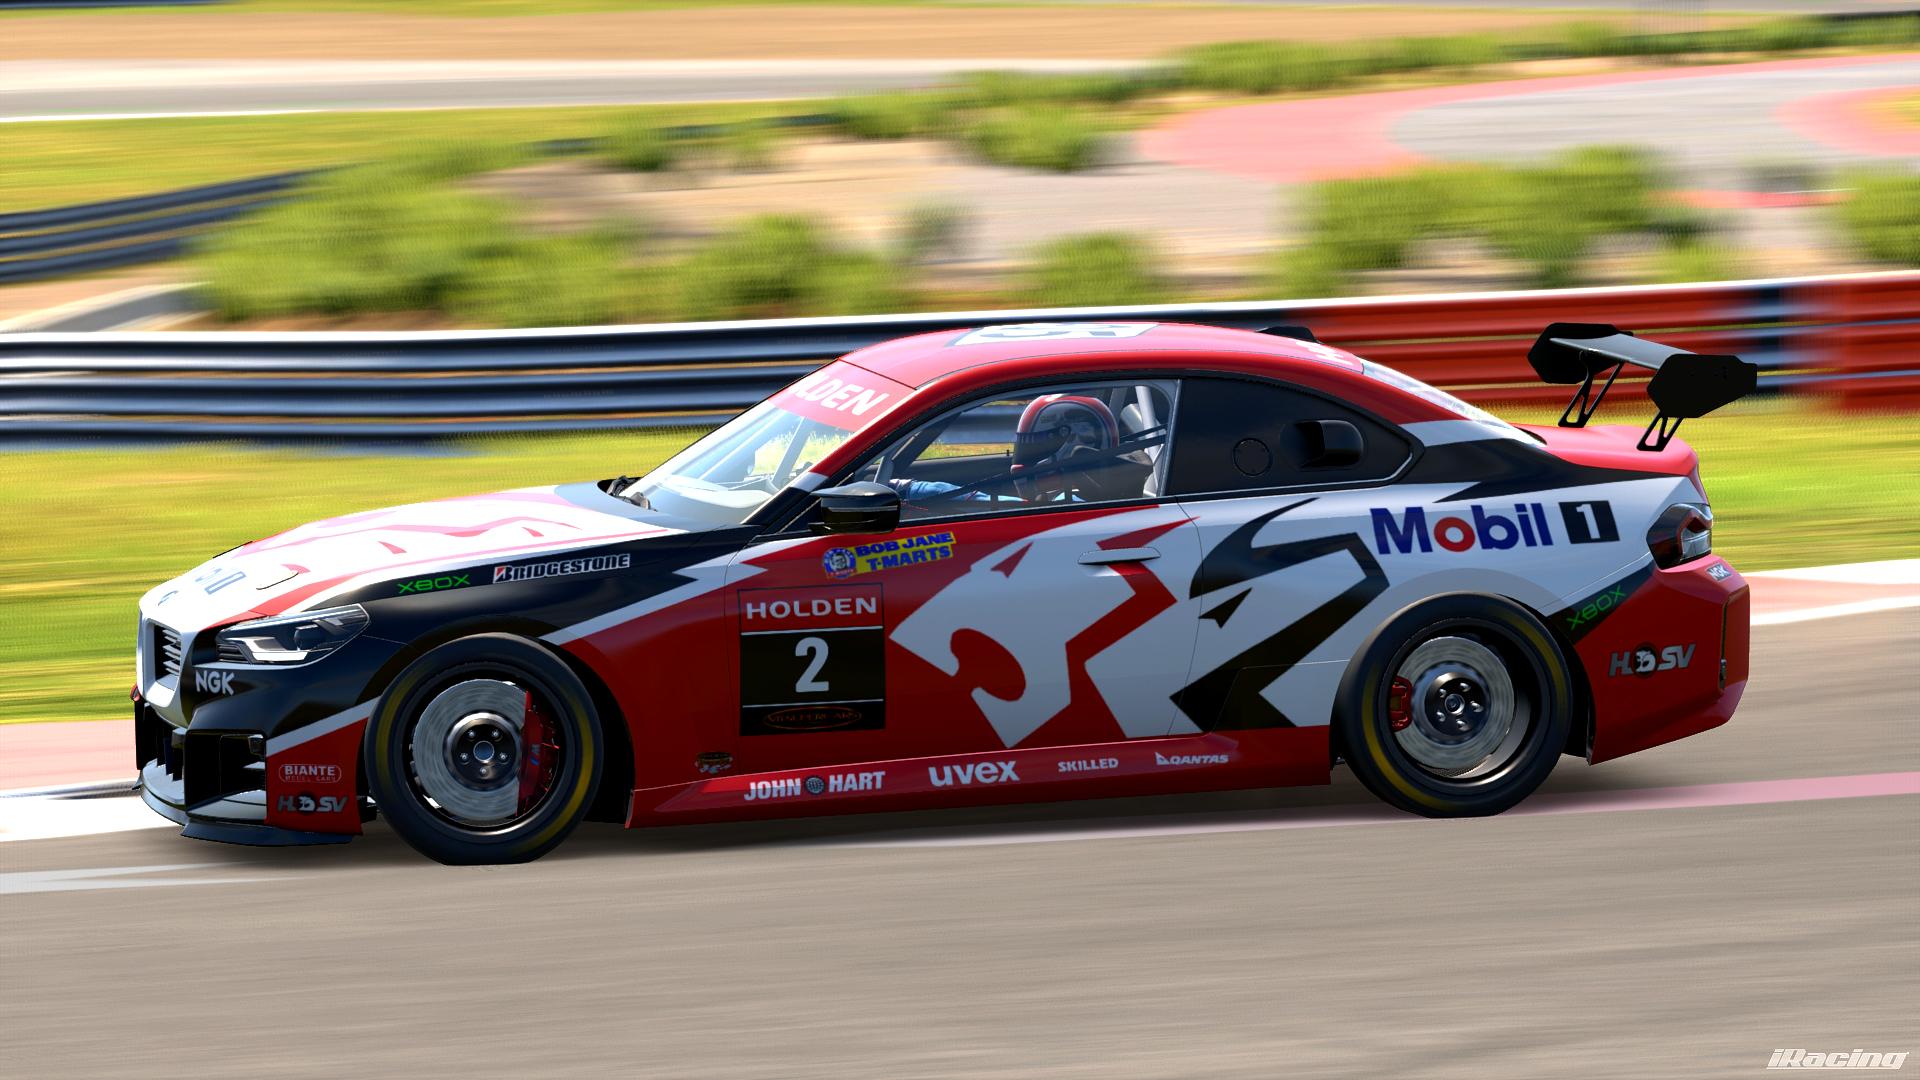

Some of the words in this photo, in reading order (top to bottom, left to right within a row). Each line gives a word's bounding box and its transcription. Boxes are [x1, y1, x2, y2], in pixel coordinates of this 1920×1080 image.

[1370, 502, 1554, 553] Mobil
[1576, 503, 1602, 540] 1
[855, 541, 900, 557] BOB
[902, 532, 954, 549] JANE
[493, 553, 631, 584] BRIDGESTONE
[397, 574, 470, 594] XBOX
[746, 597, 877, 620] HOLDEN
[1566, 585, 1627, 631] XBOX
[795, 636, 829, 693] 2
[195, 669, 235, 697] NGK
[284, 765, 337, 776] BIANTE
[928, 760, 1021, 788] uvex
[1057, 758, 1119, 773] SKILLED
[1168, 754, 1230, 766] QANTAS
[744, 777, 802, 801] JOHN
[828, 771, 886, 793] HART
